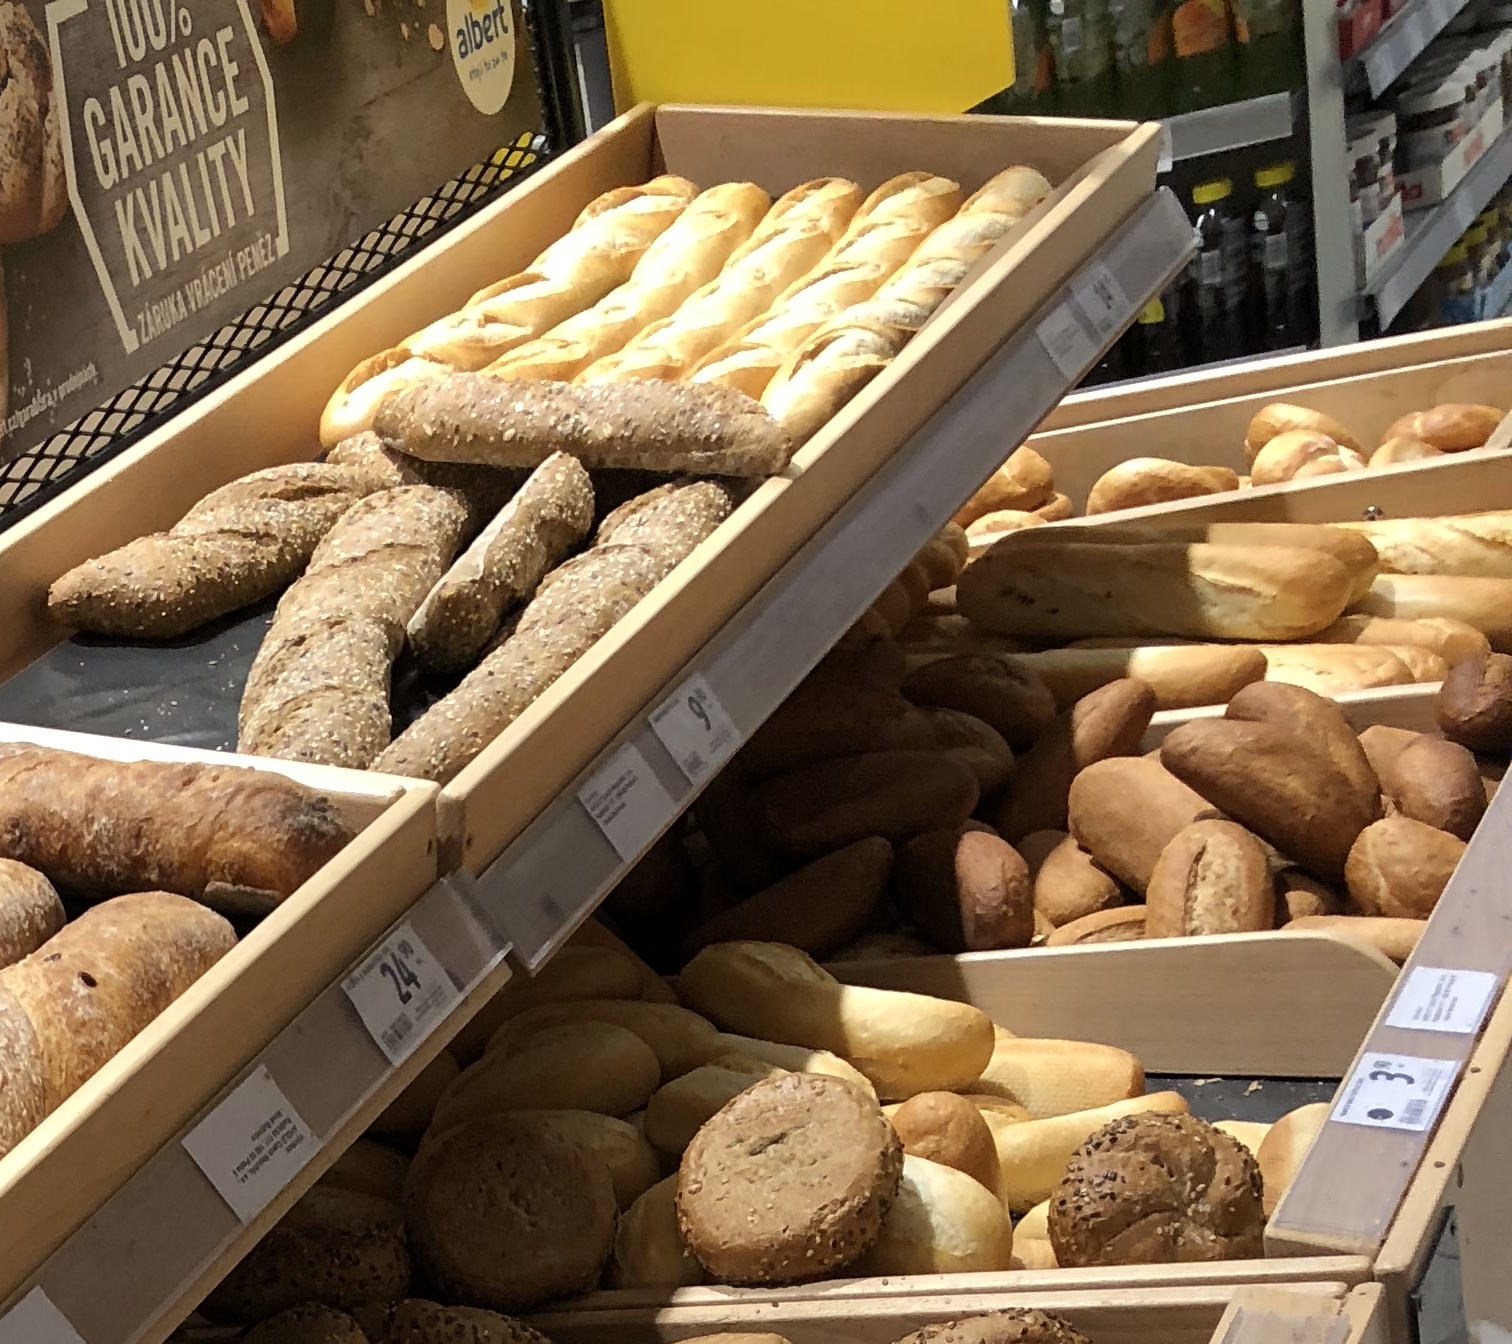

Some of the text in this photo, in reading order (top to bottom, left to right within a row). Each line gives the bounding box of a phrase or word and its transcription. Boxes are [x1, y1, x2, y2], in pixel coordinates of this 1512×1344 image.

[456, 0, 508, 59] albert
[84, 25, 249, 190] GARANCE
[115, 128, 255, 287] KVALITY
[137, 290, 187, 345] ZÁRUKA
[379, 952, 421, 1005] 24
[1369, 1070, 1415, 1085] 3
